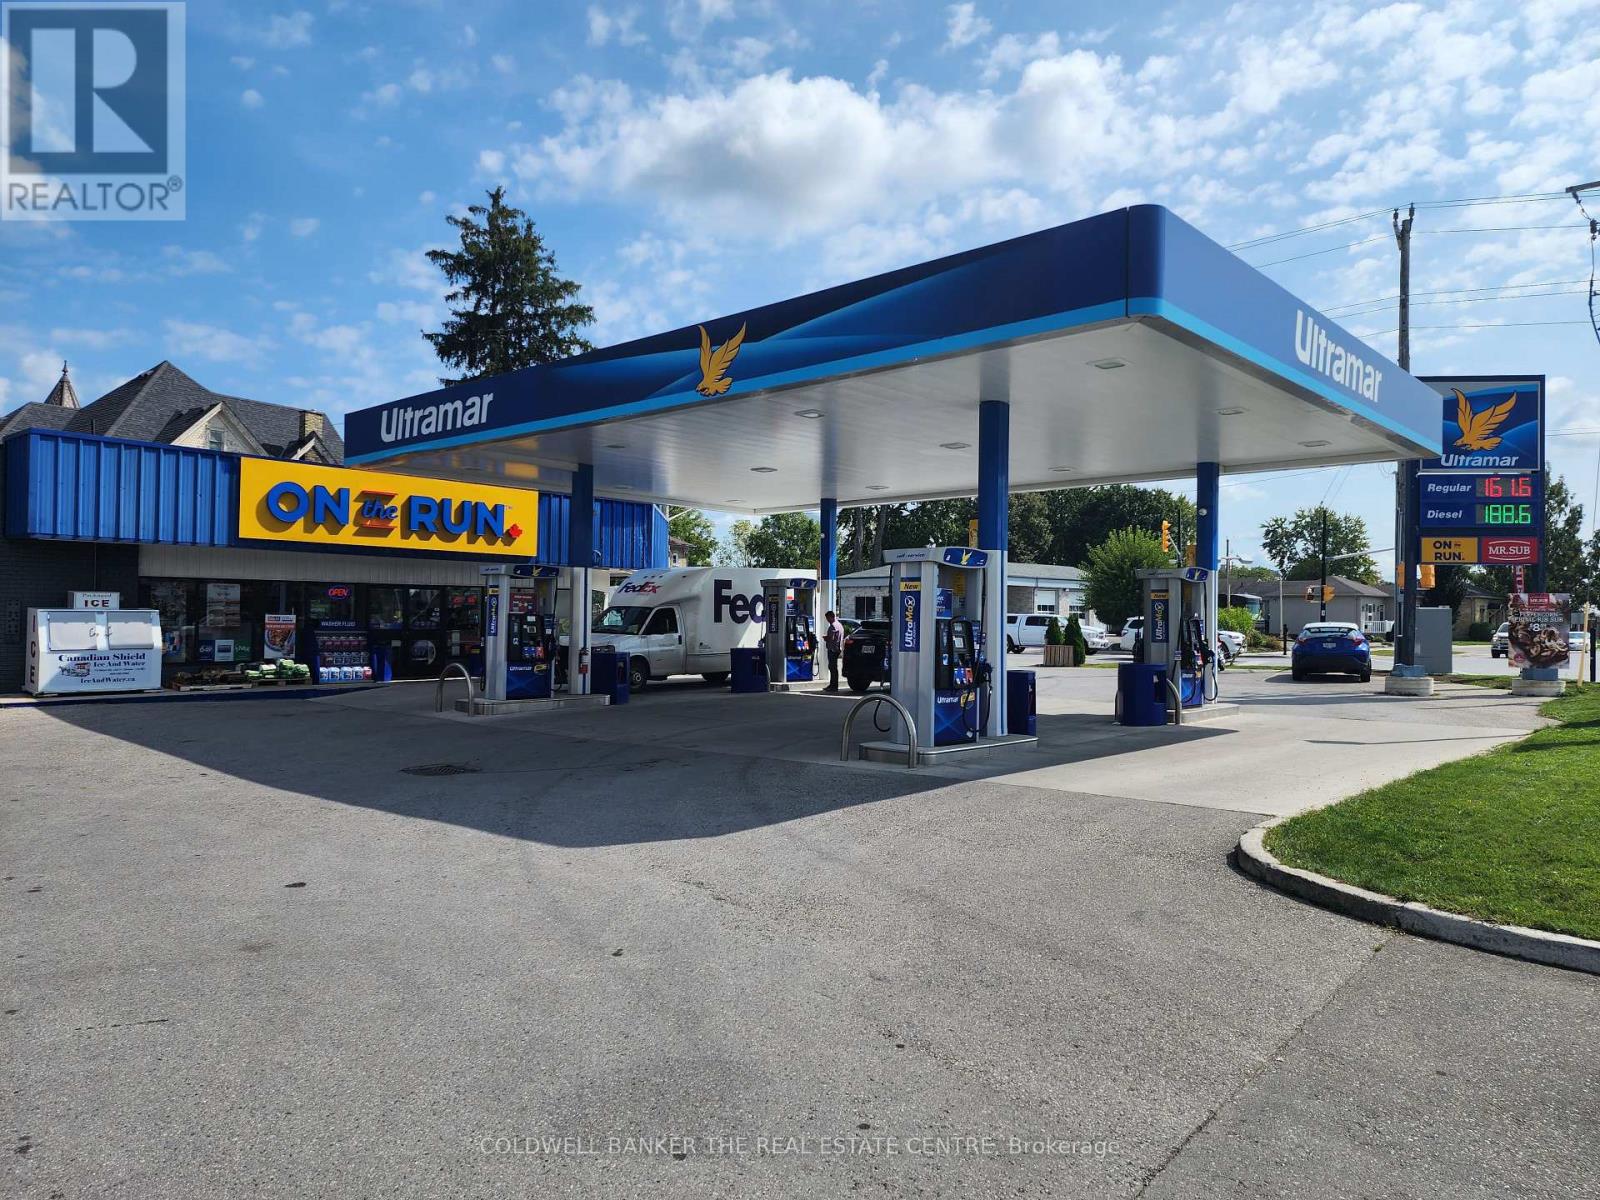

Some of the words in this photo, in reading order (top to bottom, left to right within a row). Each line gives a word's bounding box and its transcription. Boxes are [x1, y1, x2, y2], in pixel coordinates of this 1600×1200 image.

[1295, 309, 1382, 402] Ultramar
[380, 392, 494, 443] Ultramar
[1440, 454, 1519, 467] Ultramar
[1427, 483, 1472, 494] Regular
[1484, 477, 1532, 497] 161.6
[266, 481, 350, 525] ON
[360, 497, 399, 520] the
[409, 494, 505, 538] RUN
[1427, 510, 1463, 519] Diesel
[1484, 504, 1532, 524] 188.6
[1433, 540, 1452, 550] ON
[1488, 546, 1531, 555] MR.SUB
[328, 588, 348, 597] OPEN
[617, 581, 663, 594] FedEx
[84, 600, 110, 608] ICE
[58, 653, 110, 662] Canadian
[112, 652, 146, 660] Shield
